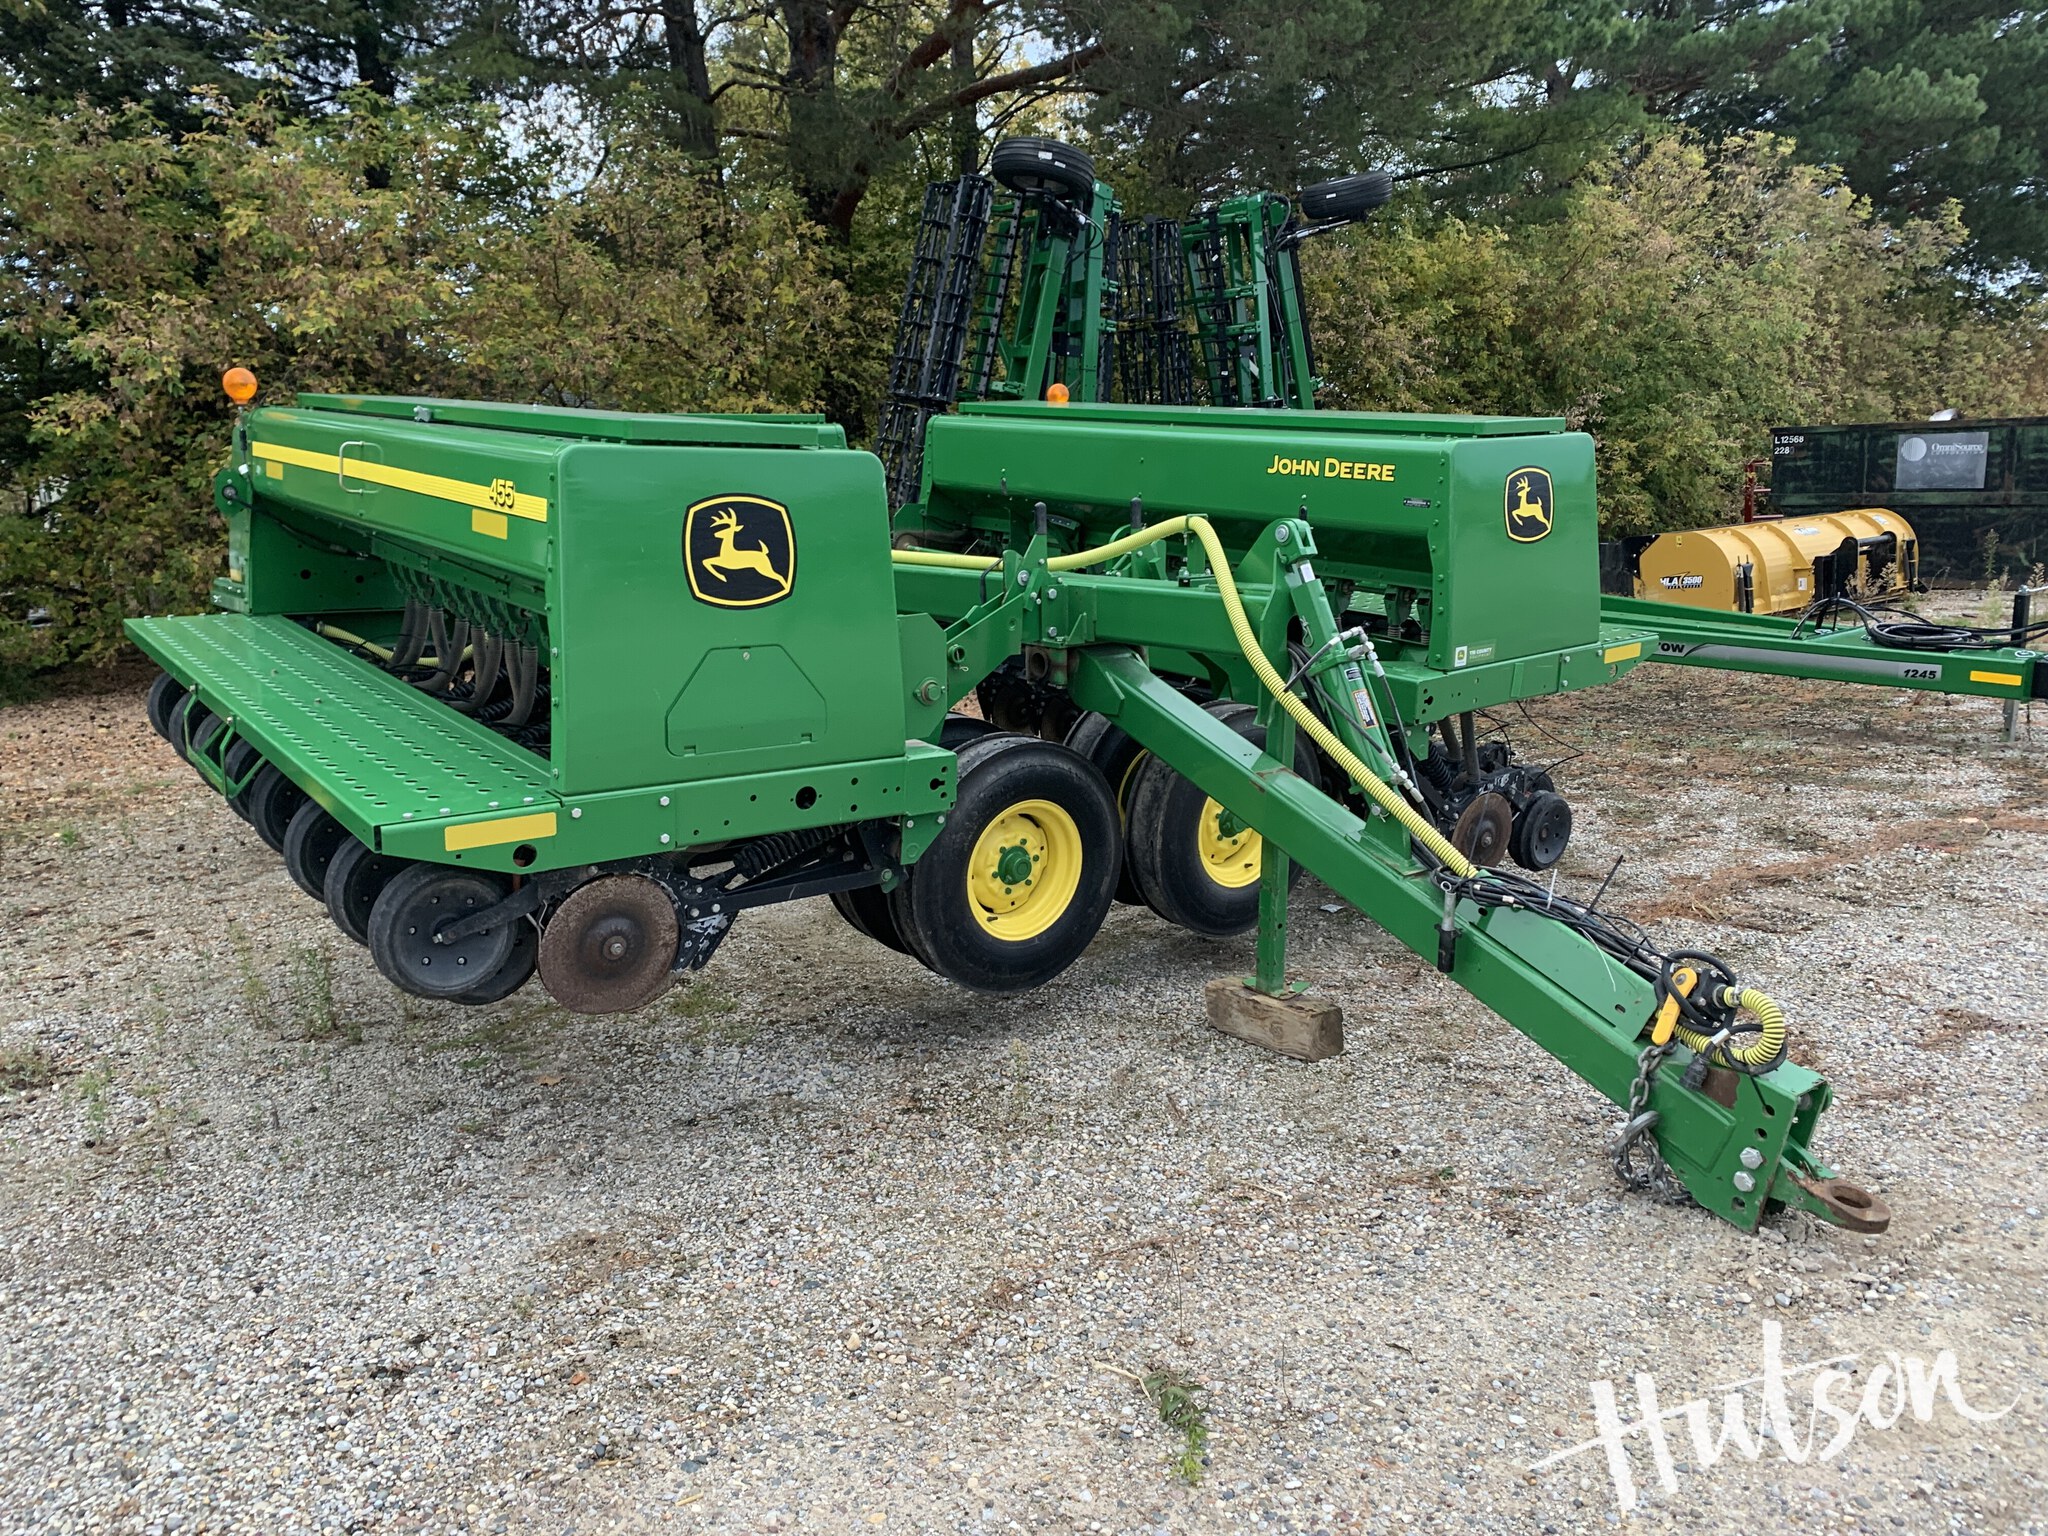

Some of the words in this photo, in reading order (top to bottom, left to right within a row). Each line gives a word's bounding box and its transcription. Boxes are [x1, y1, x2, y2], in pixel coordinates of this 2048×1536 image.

[1774, 435, 1805, 444] L12568
[1931, 443, 1983, 451] OmniSource
[488, 477, 515, 509] 455
[1683, 576, 1703, 585] 3500
[1658, 641, 1685, 653] OW
[1904, 669, 1937, 680] 1245
